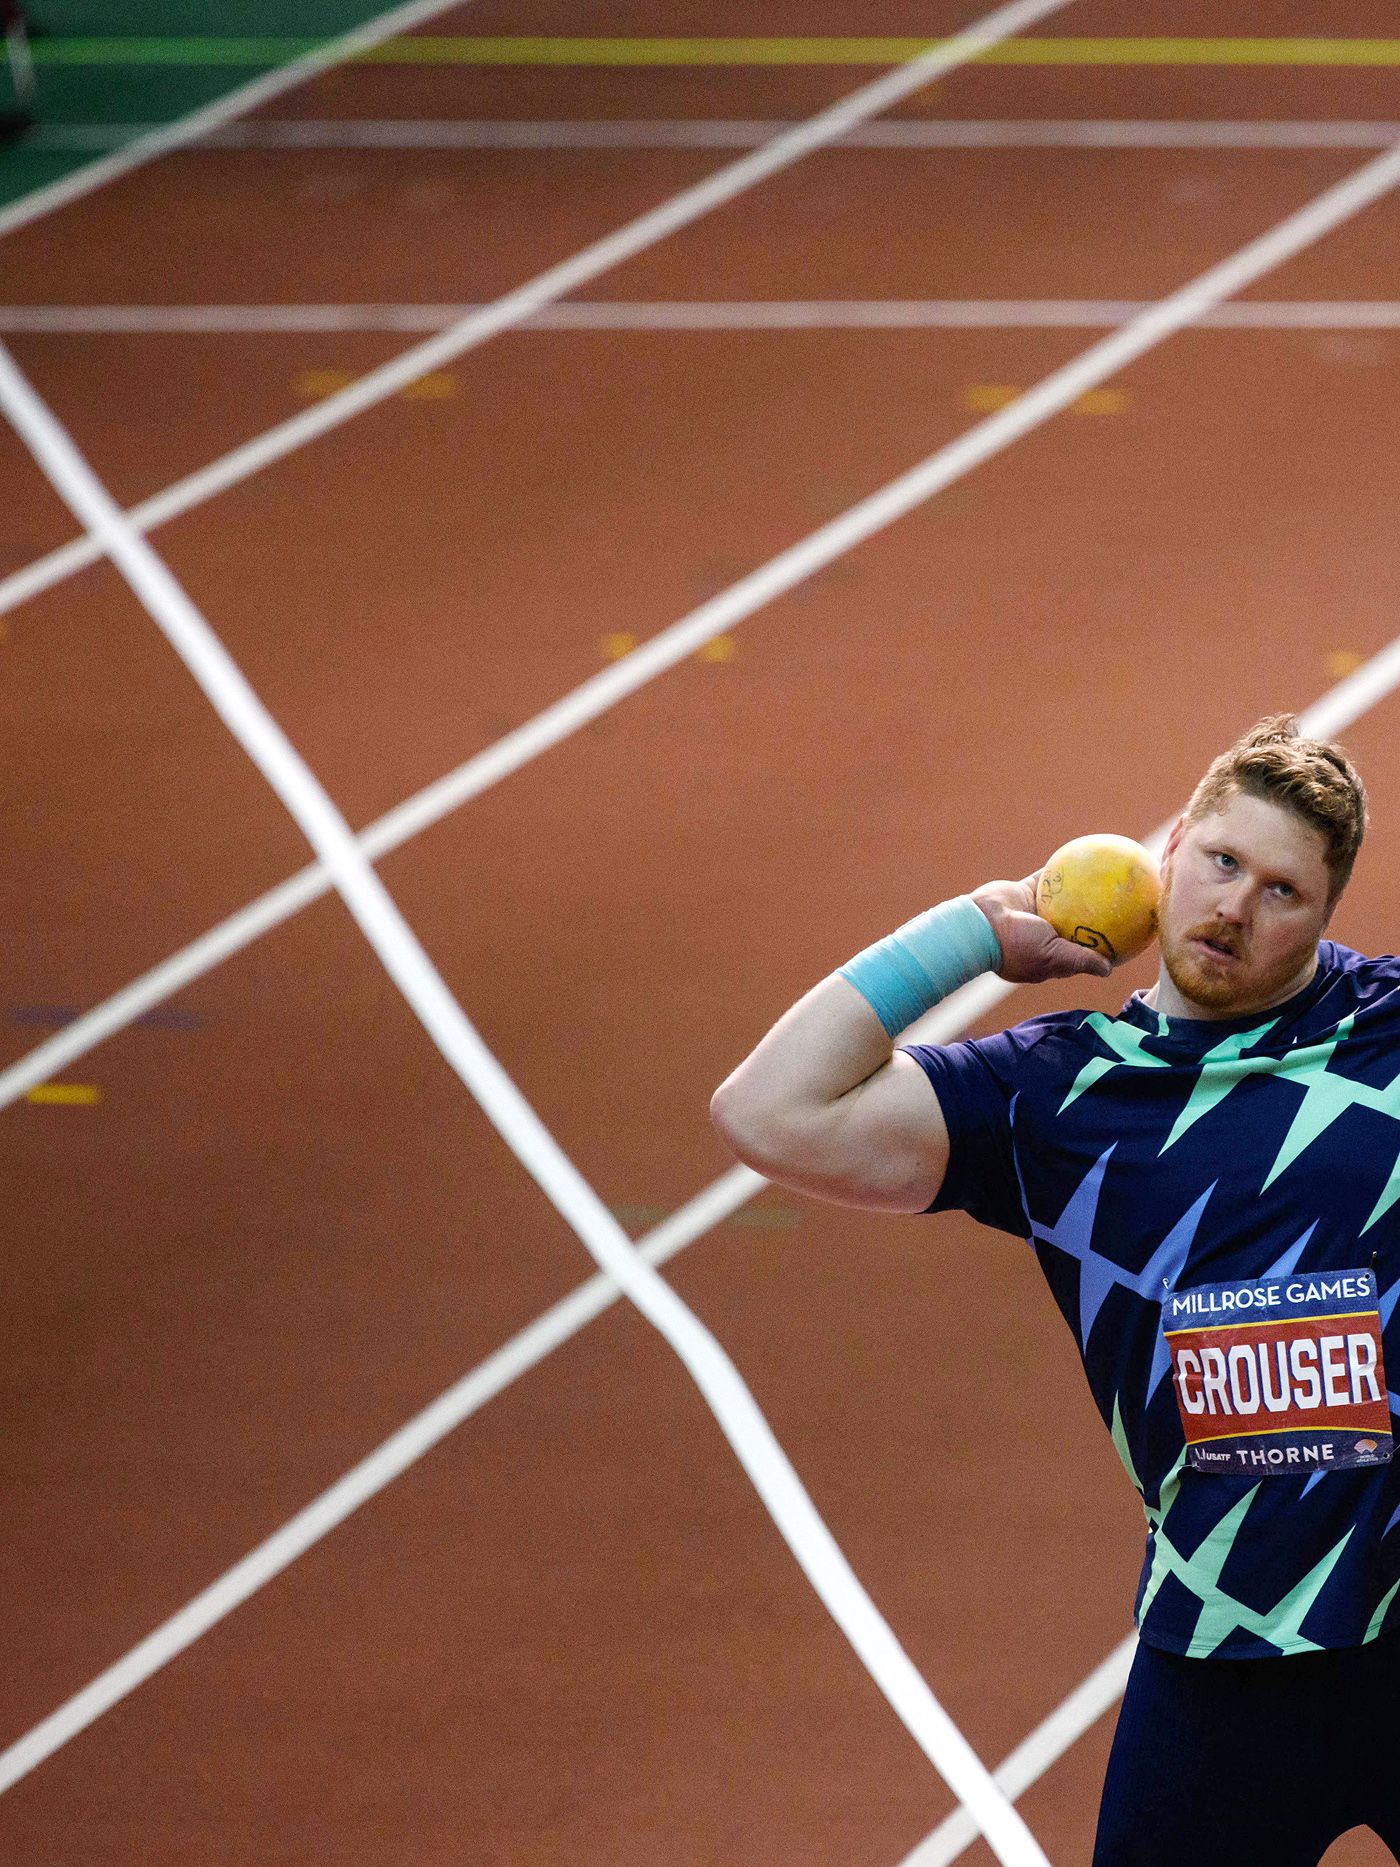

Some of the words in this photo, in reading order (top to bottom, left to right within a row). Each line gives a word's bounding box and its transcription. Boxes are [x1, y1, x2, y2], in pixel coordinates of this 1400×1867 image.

[1172, 1285, 1281, 1316] MILLROSE
[1286, 1277, 1371, 1303] GAMES
[1176, 1333, 1382, 1415] CROUSER
[1206, 1452, 1231, 1461] USATF
[1236, 1443, 1335, 1466] THORNE
